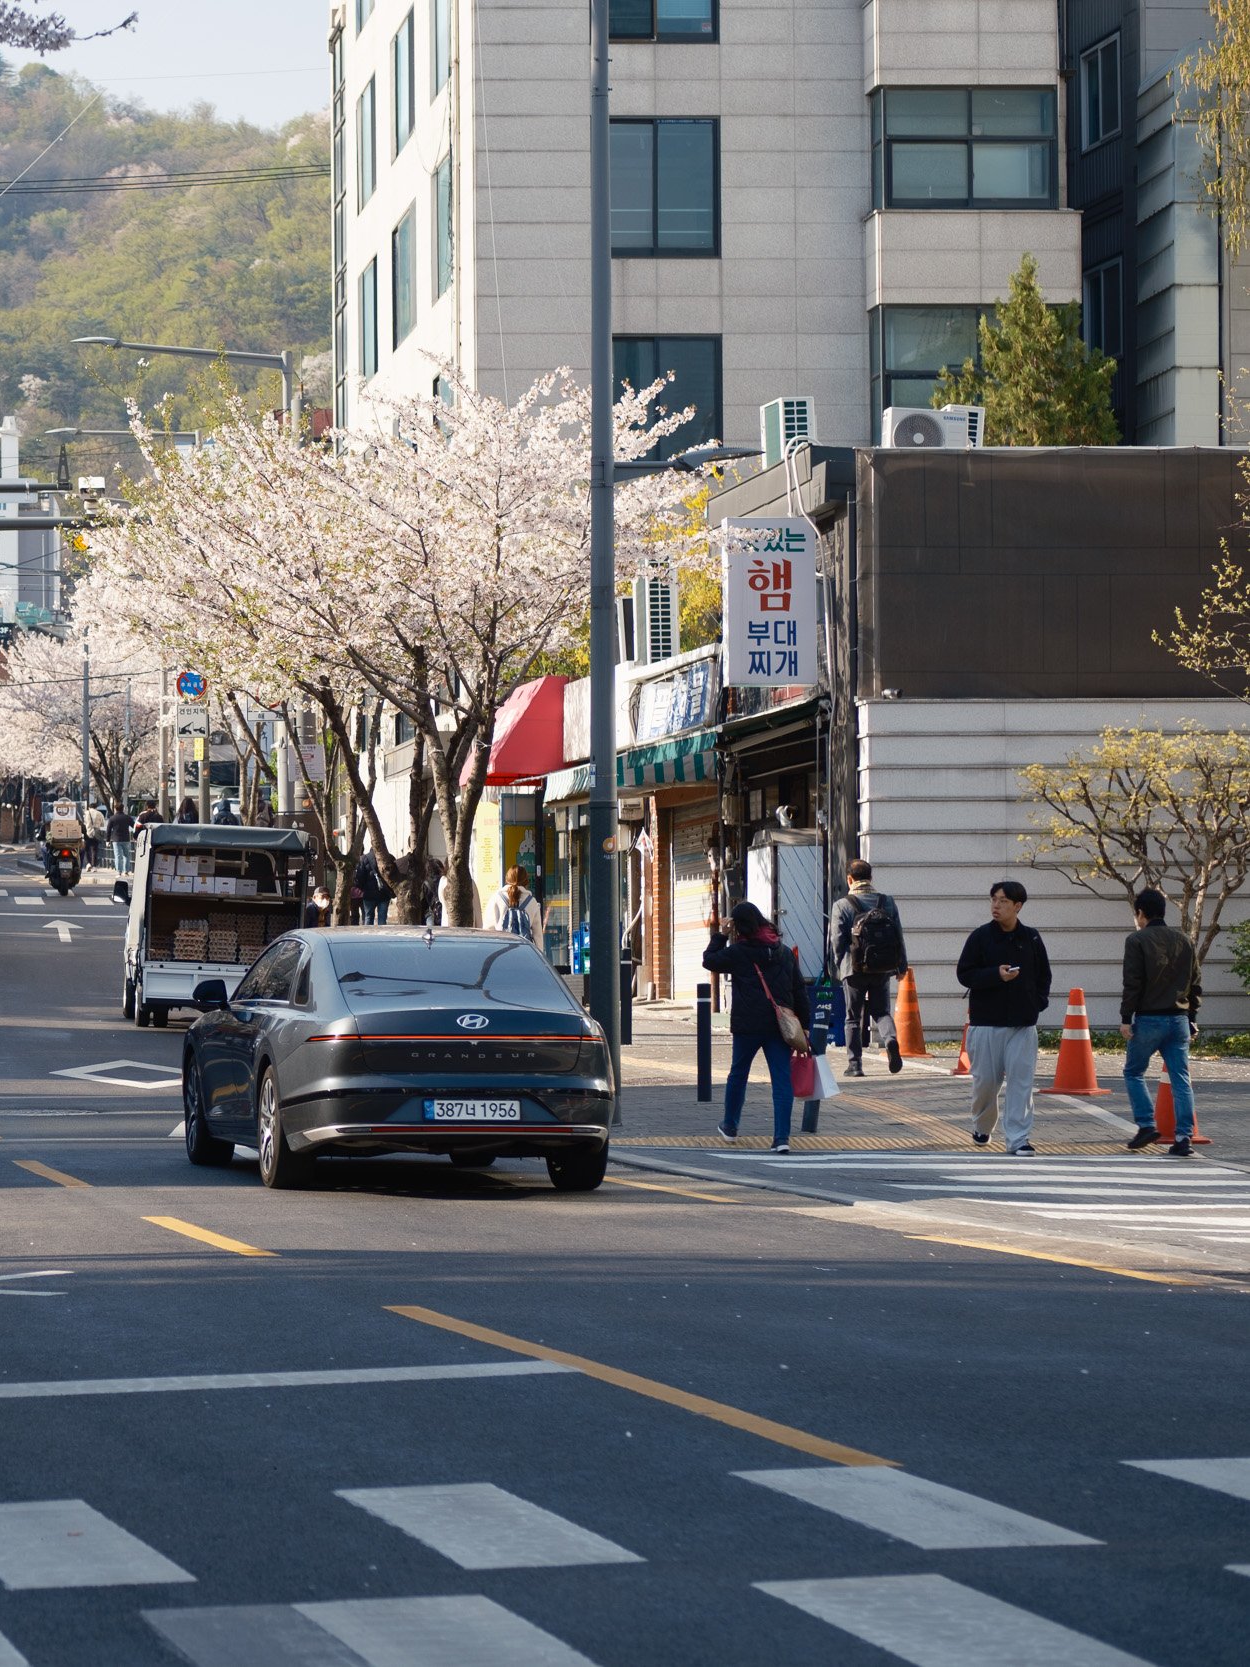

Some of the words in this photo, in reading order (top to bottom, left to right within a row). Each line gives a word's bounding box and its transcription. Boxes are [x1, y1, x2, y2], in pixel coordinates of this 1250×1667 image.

[748, 527, 807, 553] 있는
[747, 558, 793, 612] 햄
[747, 620, 797, 646] 부대
[747, 650, 799, 677] 찌개
[179, 707, 206, 715] 견인지역
[436, 1102, 477, 1118] 387너
[480, 1102, 518, 1118] 1956
